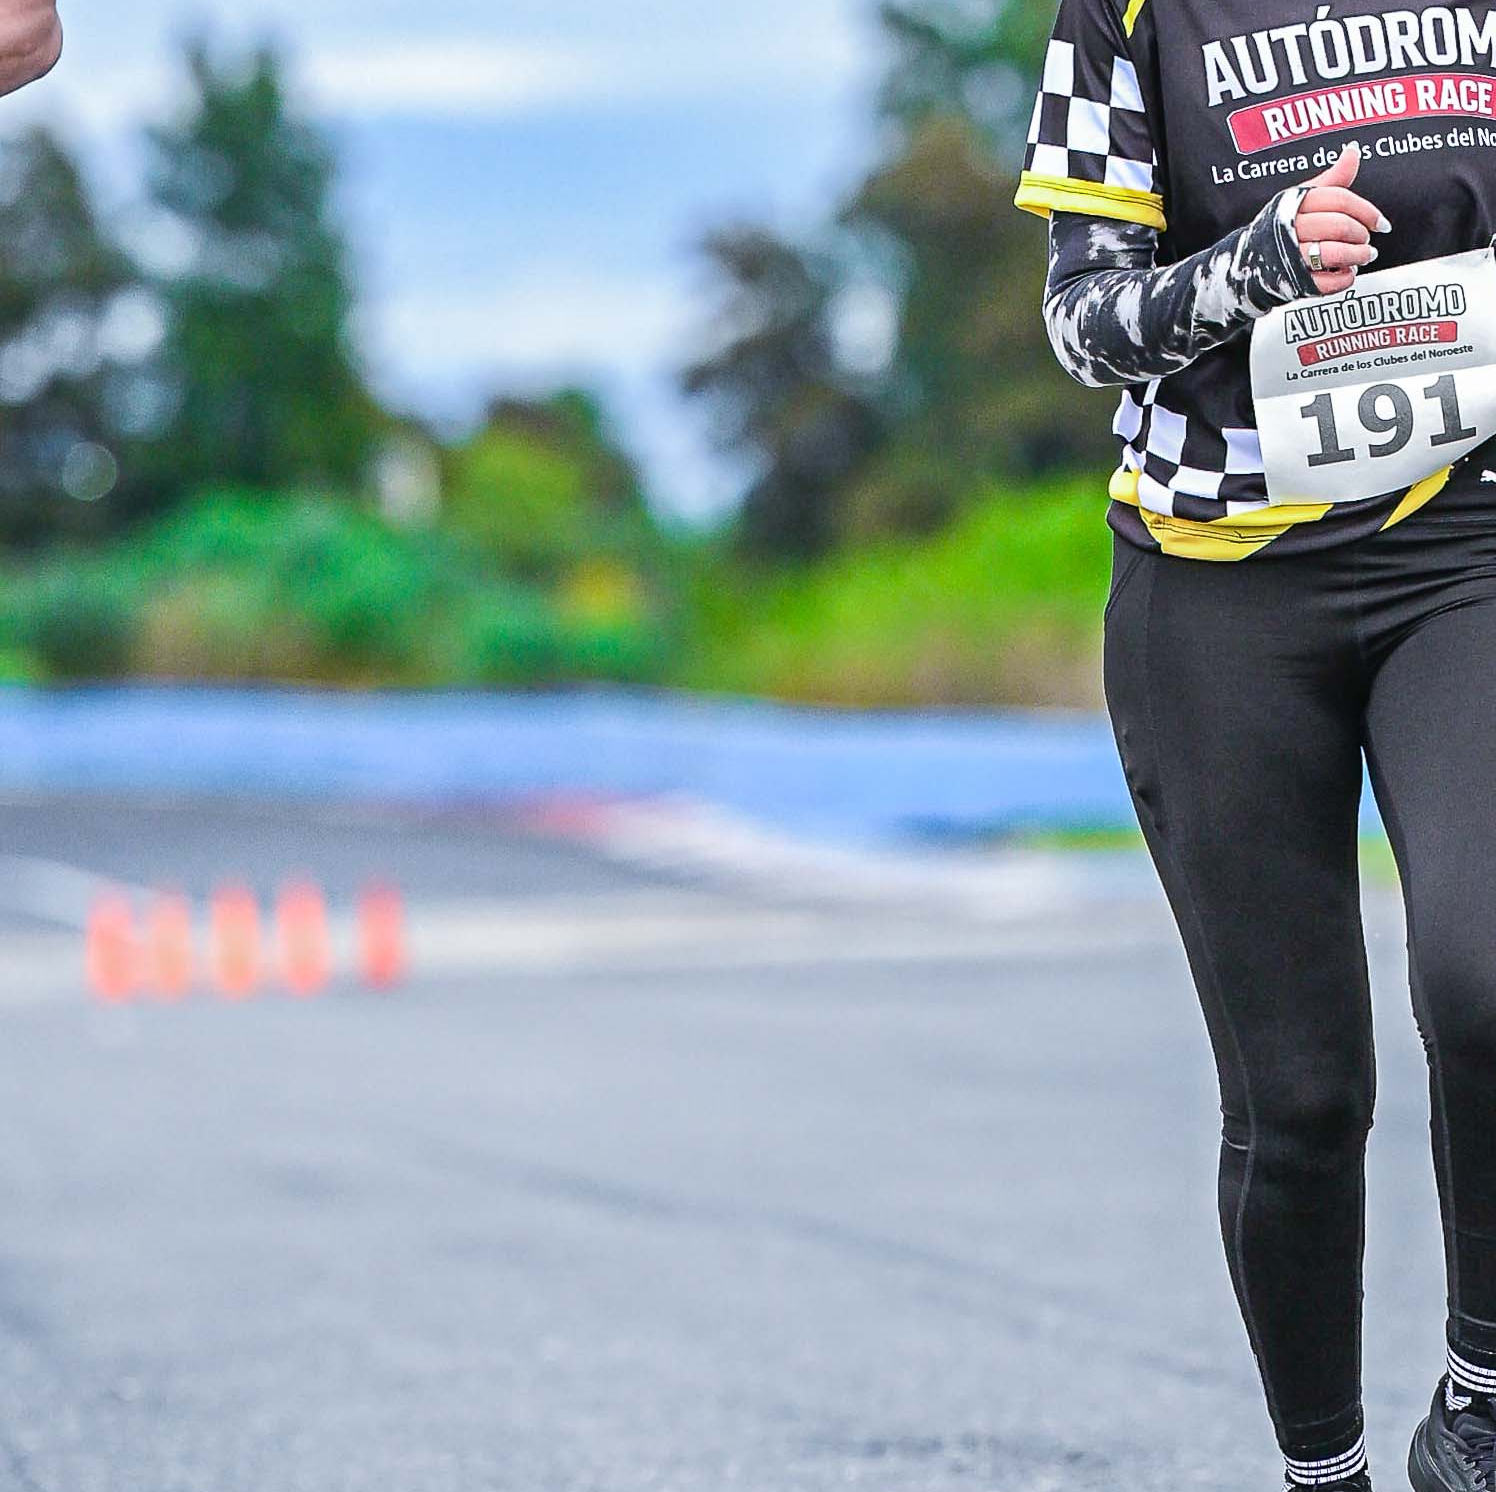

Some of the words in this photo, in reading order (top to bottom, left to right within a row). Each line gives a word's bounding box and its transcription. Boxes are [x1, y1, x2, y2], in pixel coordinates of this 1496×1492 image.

[1262, 82, 1407, 142] RUNNING
[1415, 79, 1493, 115] RACE
[1375, 132, 1443, 157] Clubes
[1448, 128, 1475, 148] del
[1212, 165, 1234, 184] La
[1237, 154, 1309, 180] Carrera
[1312, 146, 1338, 168] de
[1284, 283, 1466, 344] AUTÓDROMO
[1315, 329, 1391, 360] RUNNING
[1395, 324, 1440, 345] RACE
[1286, 371, 1298, 381] La
[1300, 366, 1339, 379] Carrera
[1341, 362, 1355, 373] de
[1357, 359, 1372, 370] los
[1373, 354, 1409, 367] Clubes
[1411, 351, 1427, 362] del
[1429, 344, 1474, 359] Noroeste
[1300, 374, 1477, 467] 191
